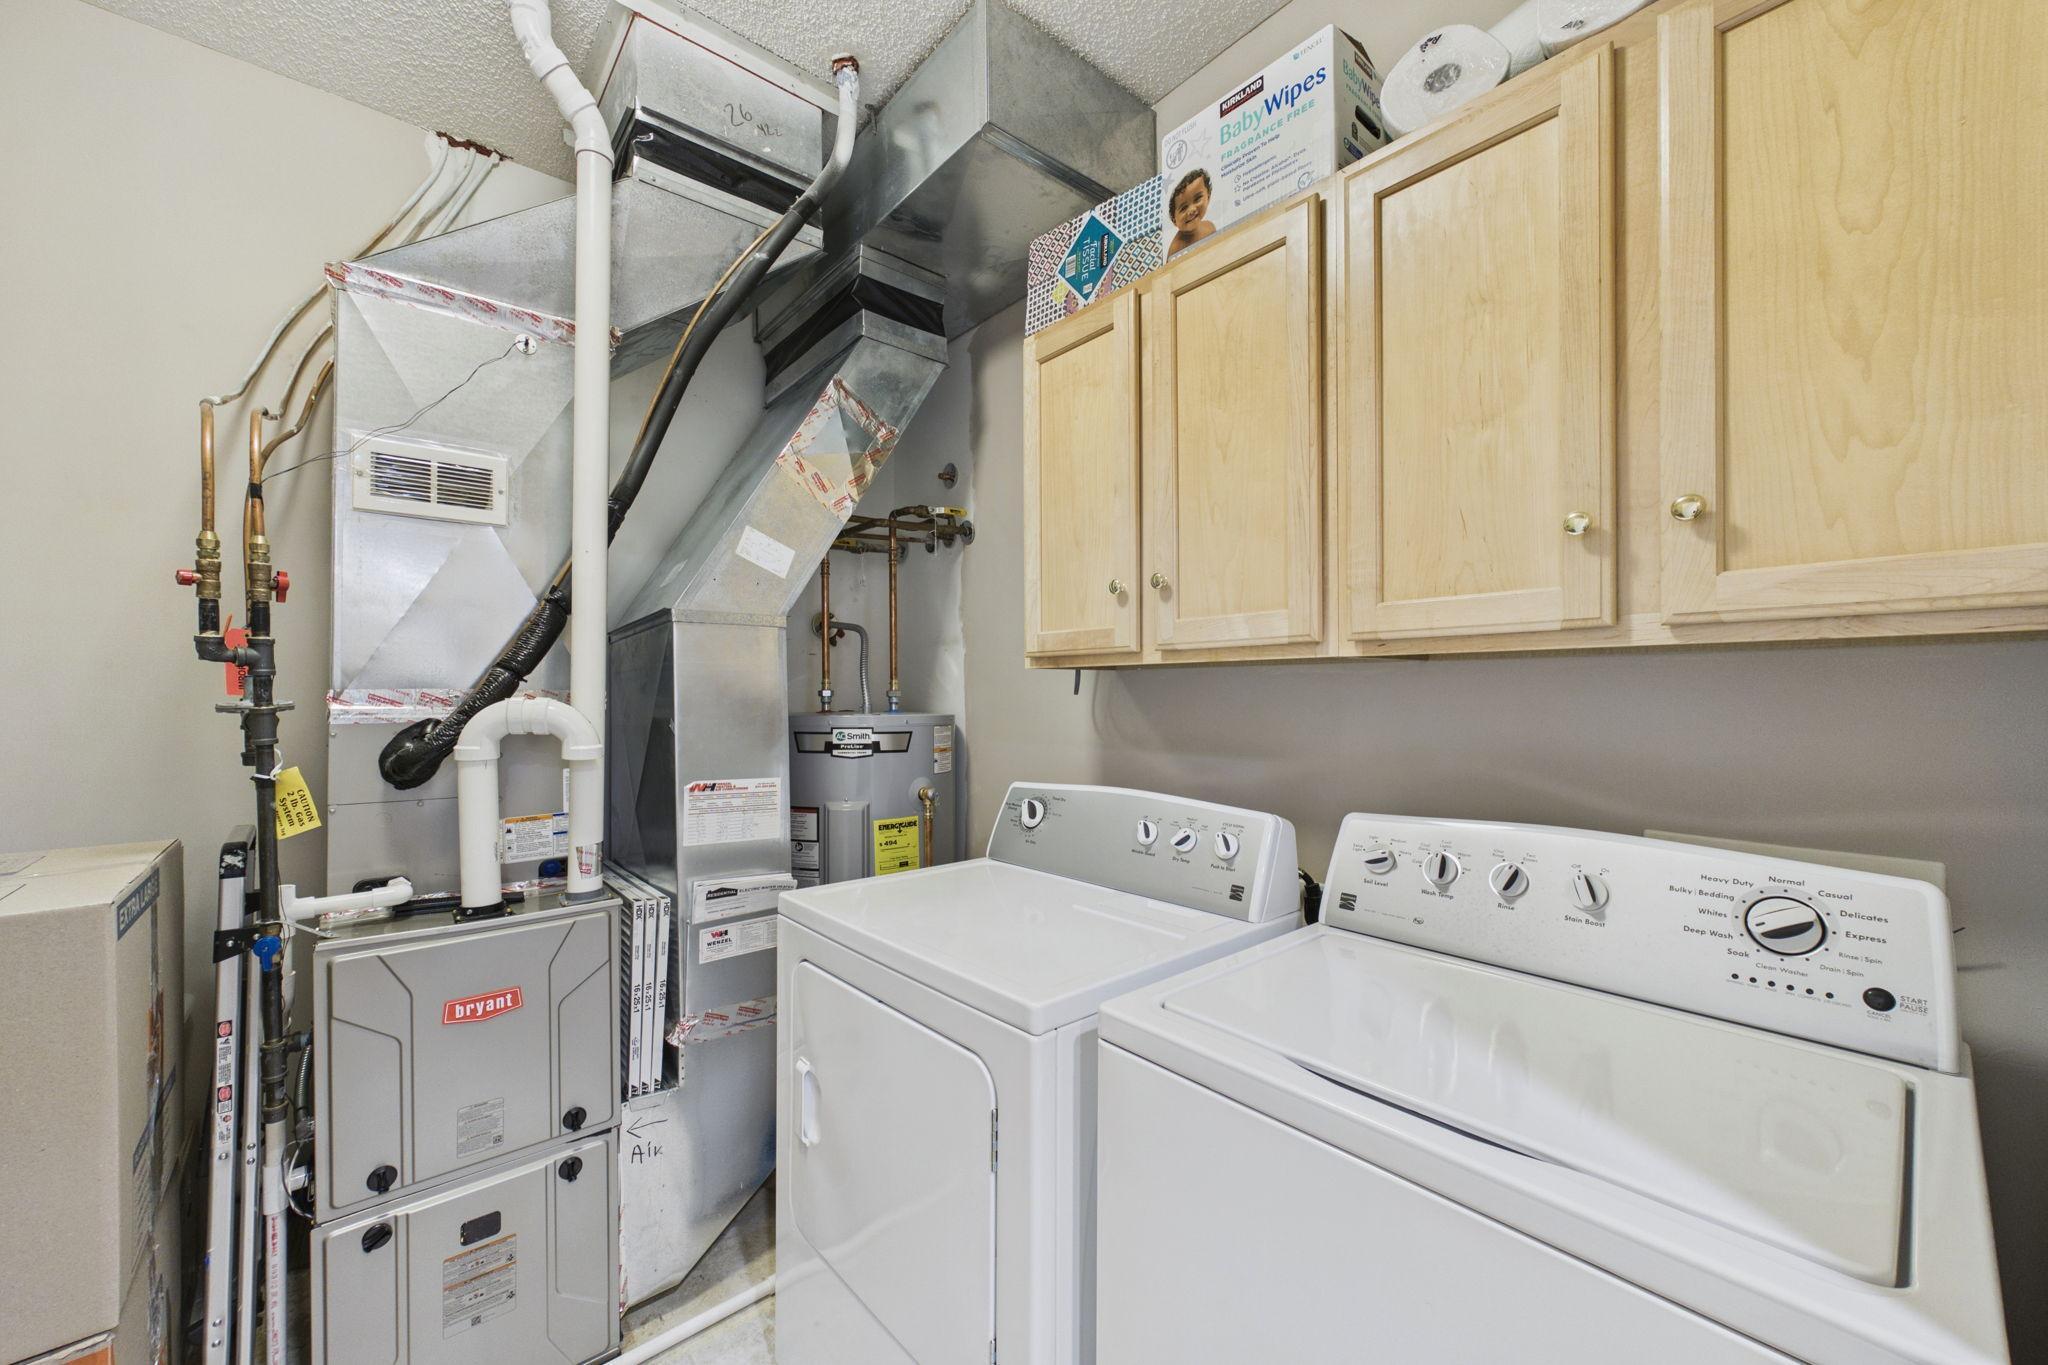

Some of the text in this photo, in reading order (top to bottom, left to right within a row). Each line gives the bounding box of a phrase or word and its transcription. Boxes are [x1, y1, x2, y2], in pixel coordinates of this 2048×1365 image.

[1222, 79, 1263, 112] KIRKLAND
[1220, 66, 1327, 145] Baby Wipes
[723, 103, 753, 127] 26
[1221, 99, 1316, 161] FRAGRANCE FREE
[1081, 237, 1091, 281] TISSUE
[1089, 240, 1098, 271] Facial
[846, 732, 870, 740] Smith
[279, 797, 295, 827] System
[296, 788, 316, 823] CAUTION
[296, 811, 306, 827] Gas
[1700, 874, 1754, 889] Heavy Duty
[1768, 875, 1805, 887] Normal
[1421, 888, 1455, 900] Wash Temp
[1669, 884, 1735, 902] Bulky Bedding
[1817, 889, 1853, 901] Casual
[1497, 902, 1515, 911] Rinse
[1698, 907, 1728, 919] Whites
[1564, 914, 1606, 928] Stain Boost
[1839, 909, 1889, 924] Delicates
[1683, 925, 1734, 940] Deep Wash
[1845, 930, 1888, 945] Express
[706, 937, 733, 947] WENZEL
[1727, 947, 1750, 958] Soak
[1838, 951, 1883, 965] Rinse Spin
[1755, 962, 1809, 978] Clean Washer
[1819, 964, 1865, 978] Drain Spin
[455, 993, 513, 1019] bryant
[1900, 995, 1928, 1006] START
[1900, 1001, 1929, 1014] PAUSE
